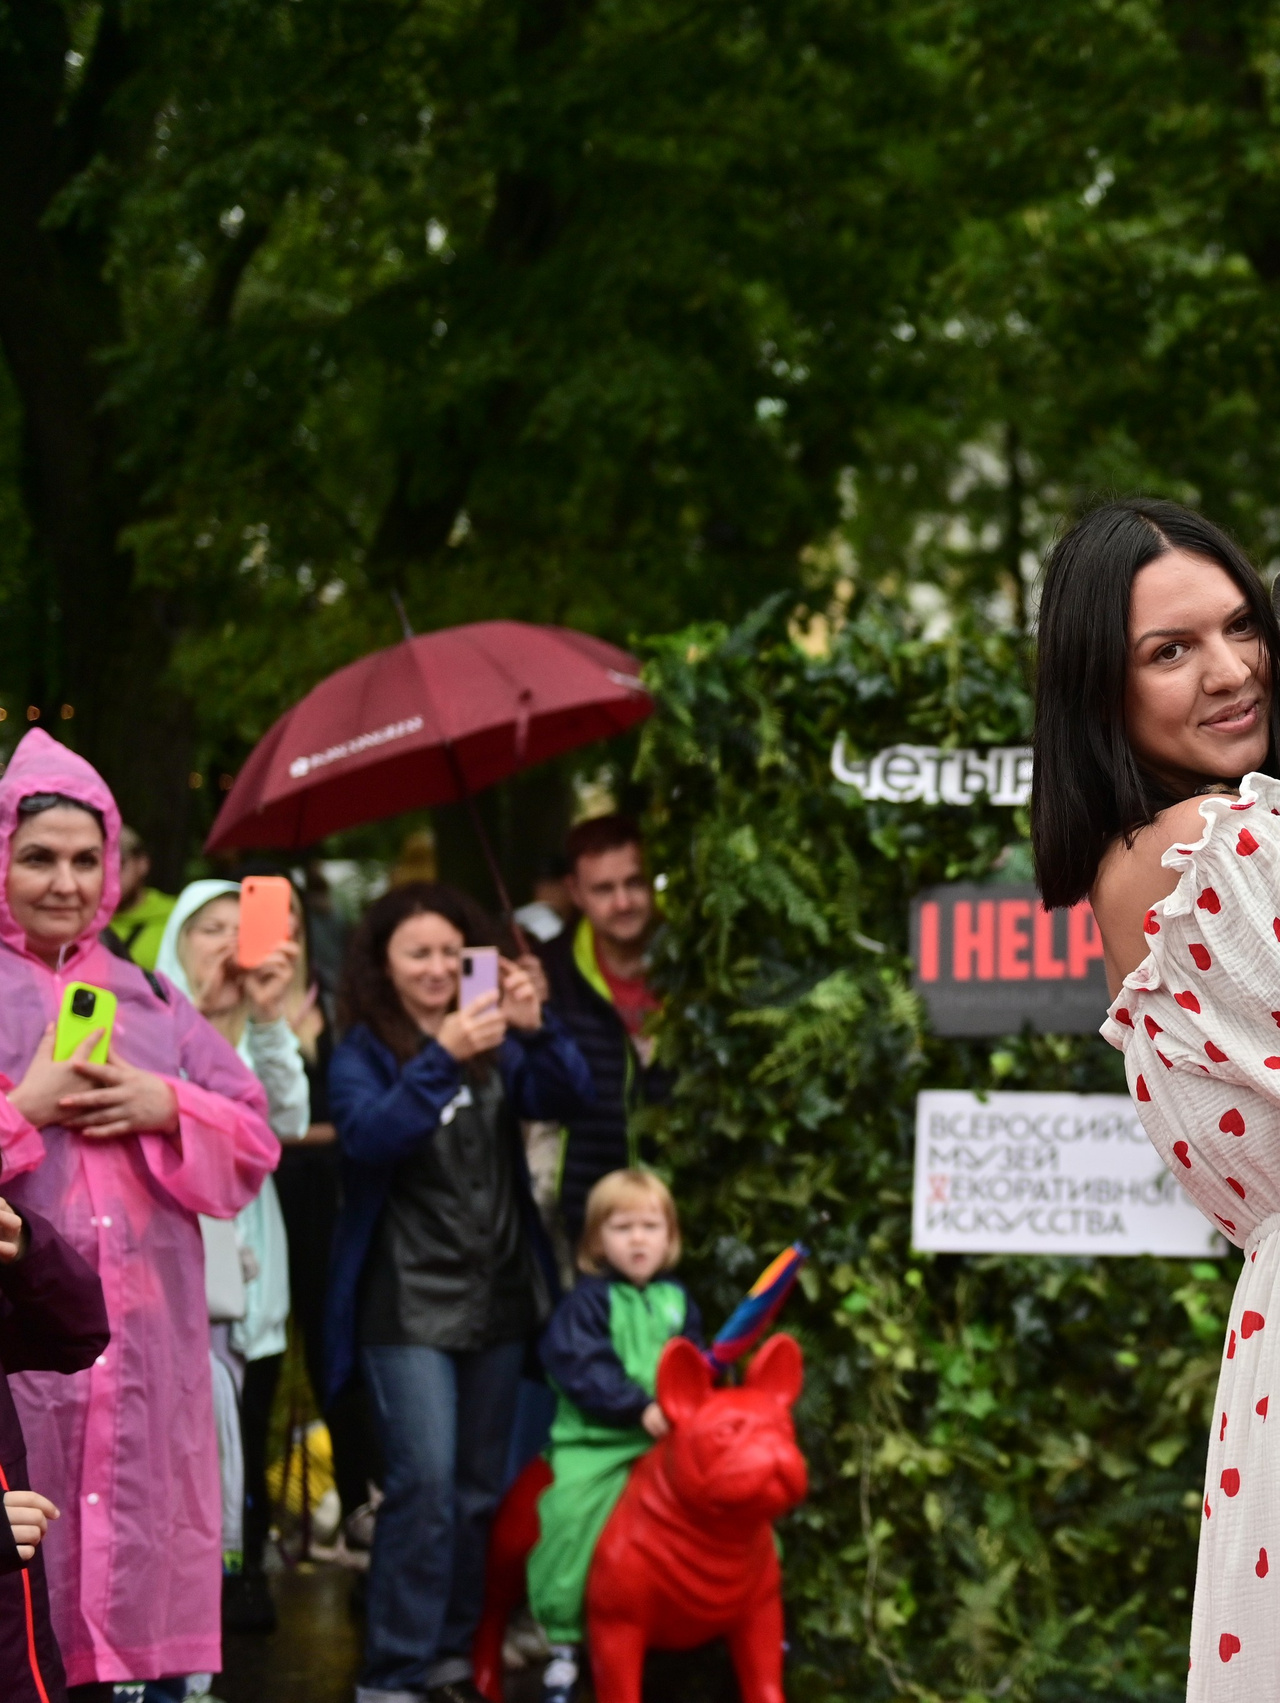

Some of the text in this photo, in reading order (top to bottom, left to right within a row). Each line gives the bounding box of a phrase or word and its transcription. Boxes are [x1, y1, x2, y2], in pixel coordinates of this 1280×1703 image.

[920, 898, 1104, 982] I HELP
[928, 1143, 1059, 1171] МУЗЕЙ
[926, 1206, 1127, 1236] ИСКУССТВА
